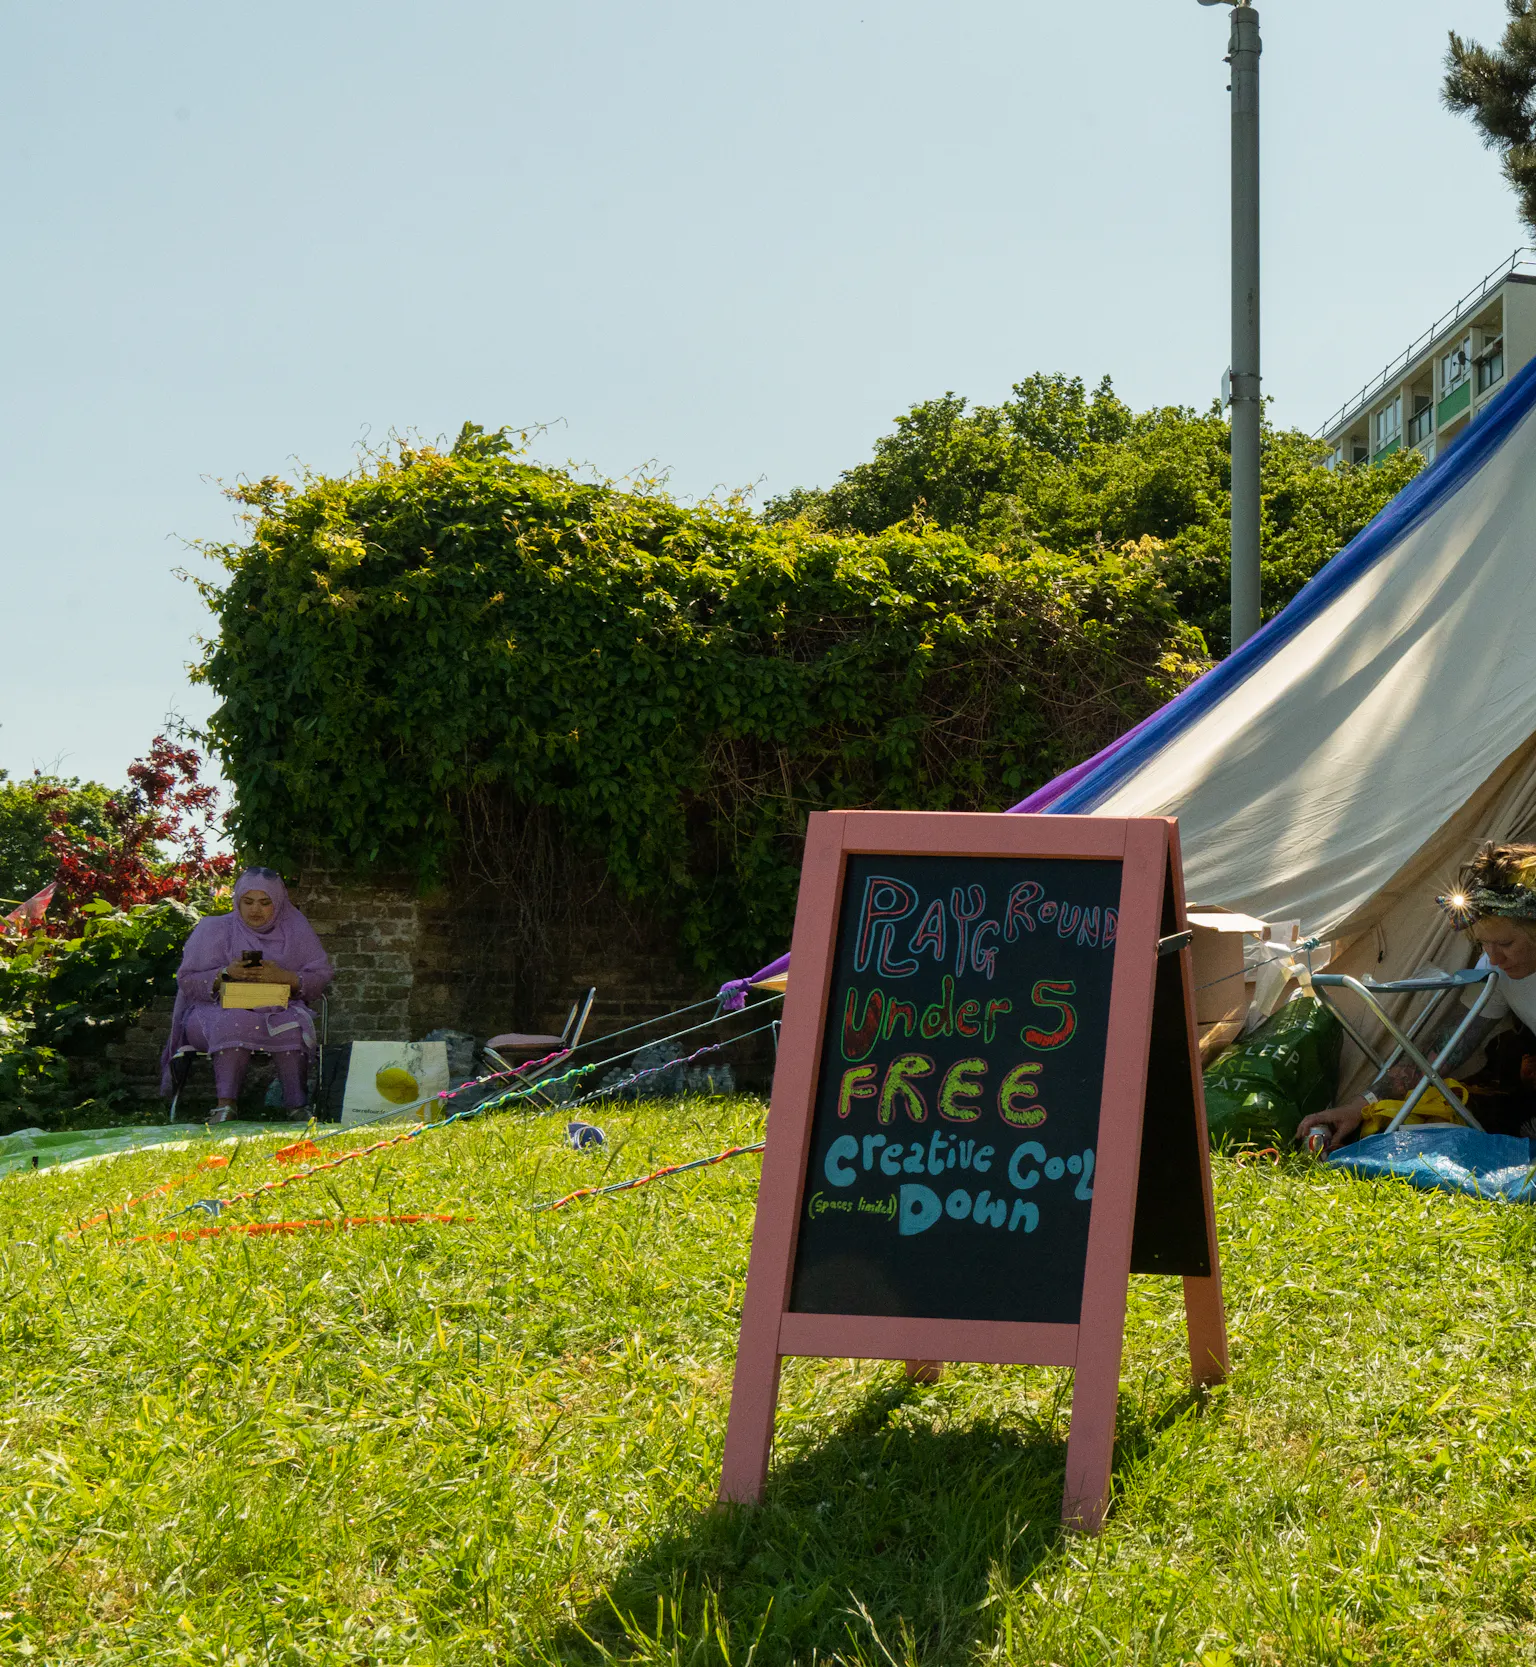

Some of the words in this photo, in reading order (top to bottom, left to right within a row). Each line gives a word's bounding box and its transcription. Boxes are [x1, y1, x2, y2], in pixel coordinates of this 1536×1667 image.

[841, 975, 1012, 1061] Under
[1020, 980, 1077, 1051] 5
[838, 1053, 1047, 1128] FREE
[824, 1130, 995, 1186] Creative
[857, 1193, 897, 1221] limited)
[899, 1183, 1040, 1236] Down
